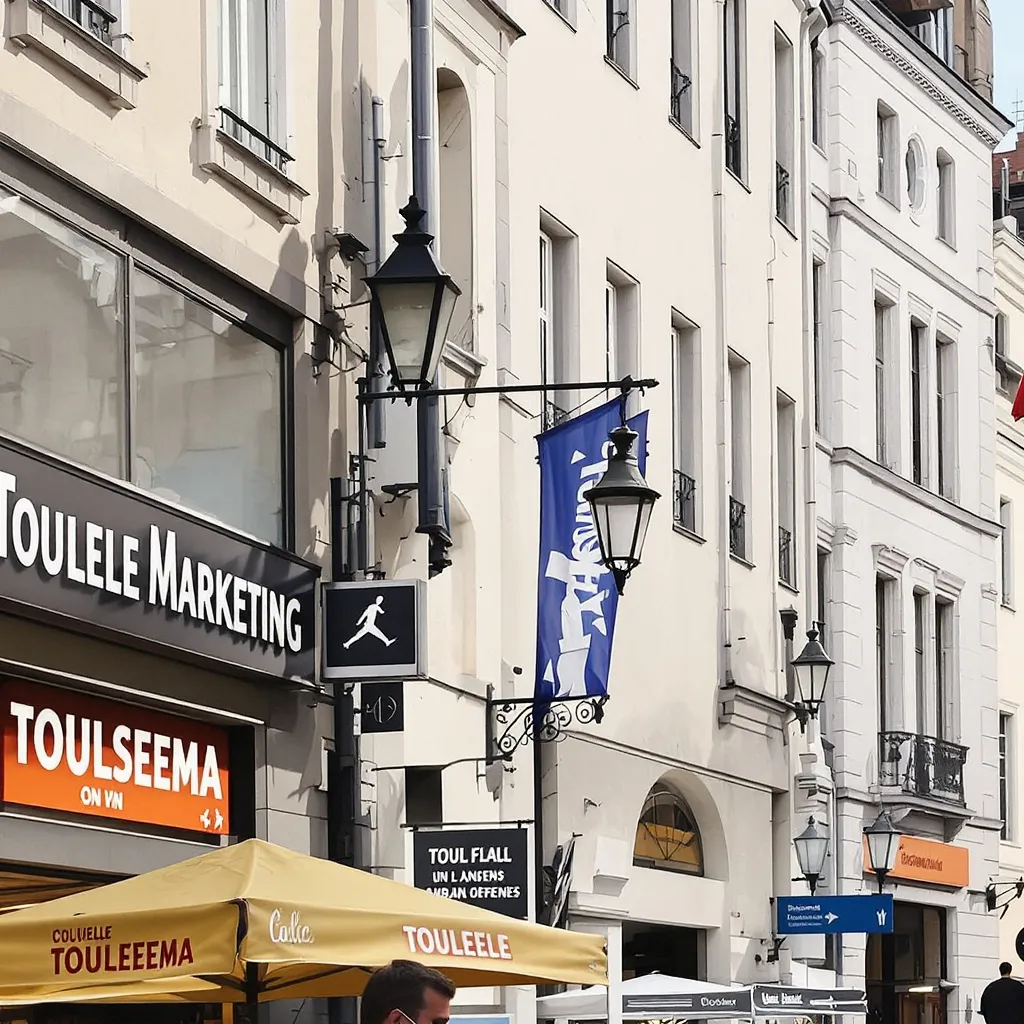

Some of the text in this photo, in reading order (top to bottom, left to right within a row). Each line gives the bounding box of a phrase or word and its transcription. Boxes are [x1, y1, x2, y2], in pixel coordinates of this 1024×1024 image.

[149, 524, 301, 652] MARKETING
[10, 701, 222, 799] TOULSEEMA
[428, 847, 468, 864] TOUL
